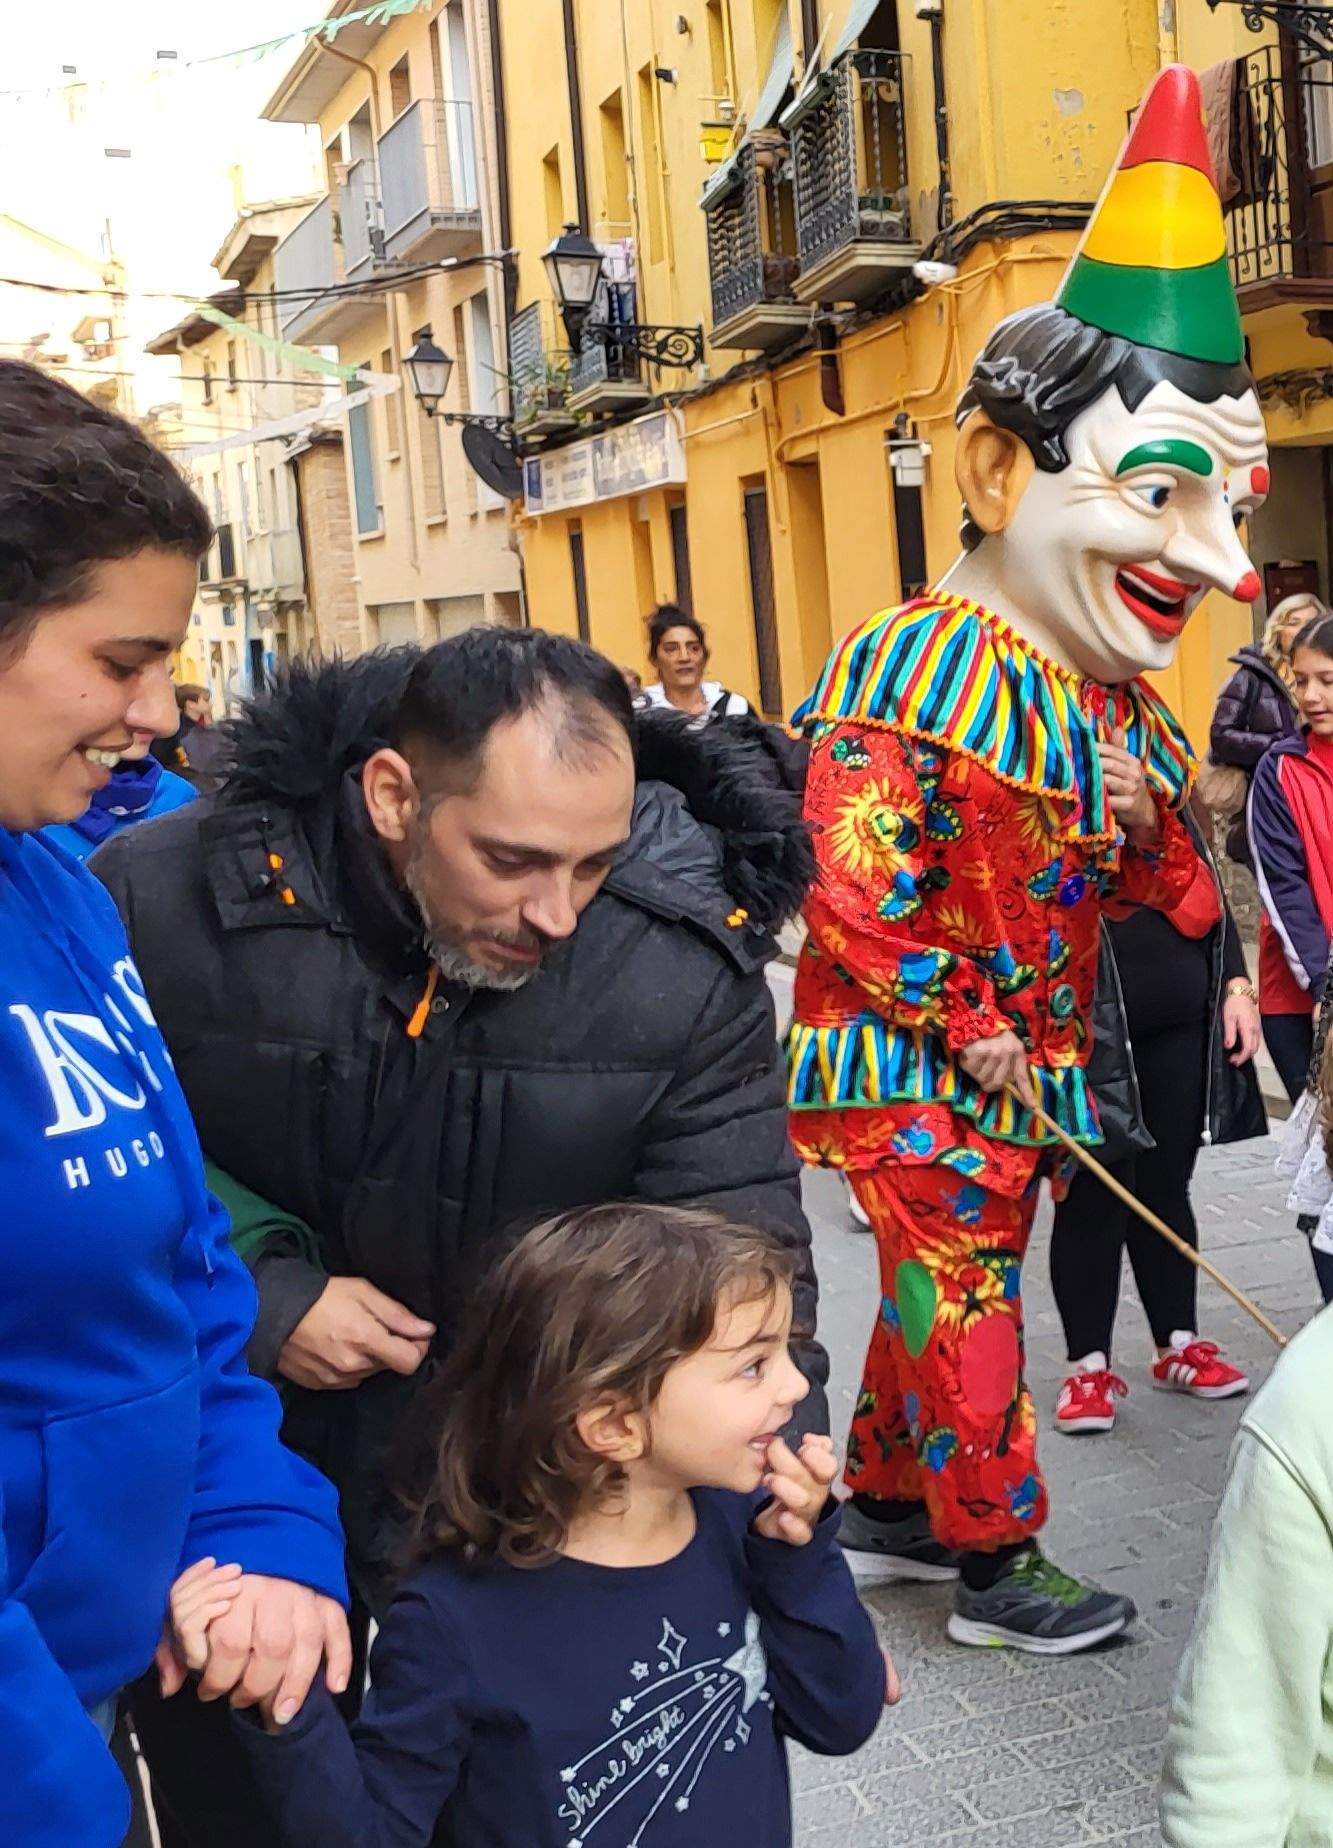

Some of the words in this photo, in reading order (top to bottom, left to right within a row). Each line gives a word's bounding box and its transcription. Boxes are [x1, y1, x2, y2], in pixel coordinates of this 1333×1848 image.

[62, 1131, 164, 1189] HUGO
[558, 1759, 626, 1831] Shine
[622, 1705, 685, 1766] bright
